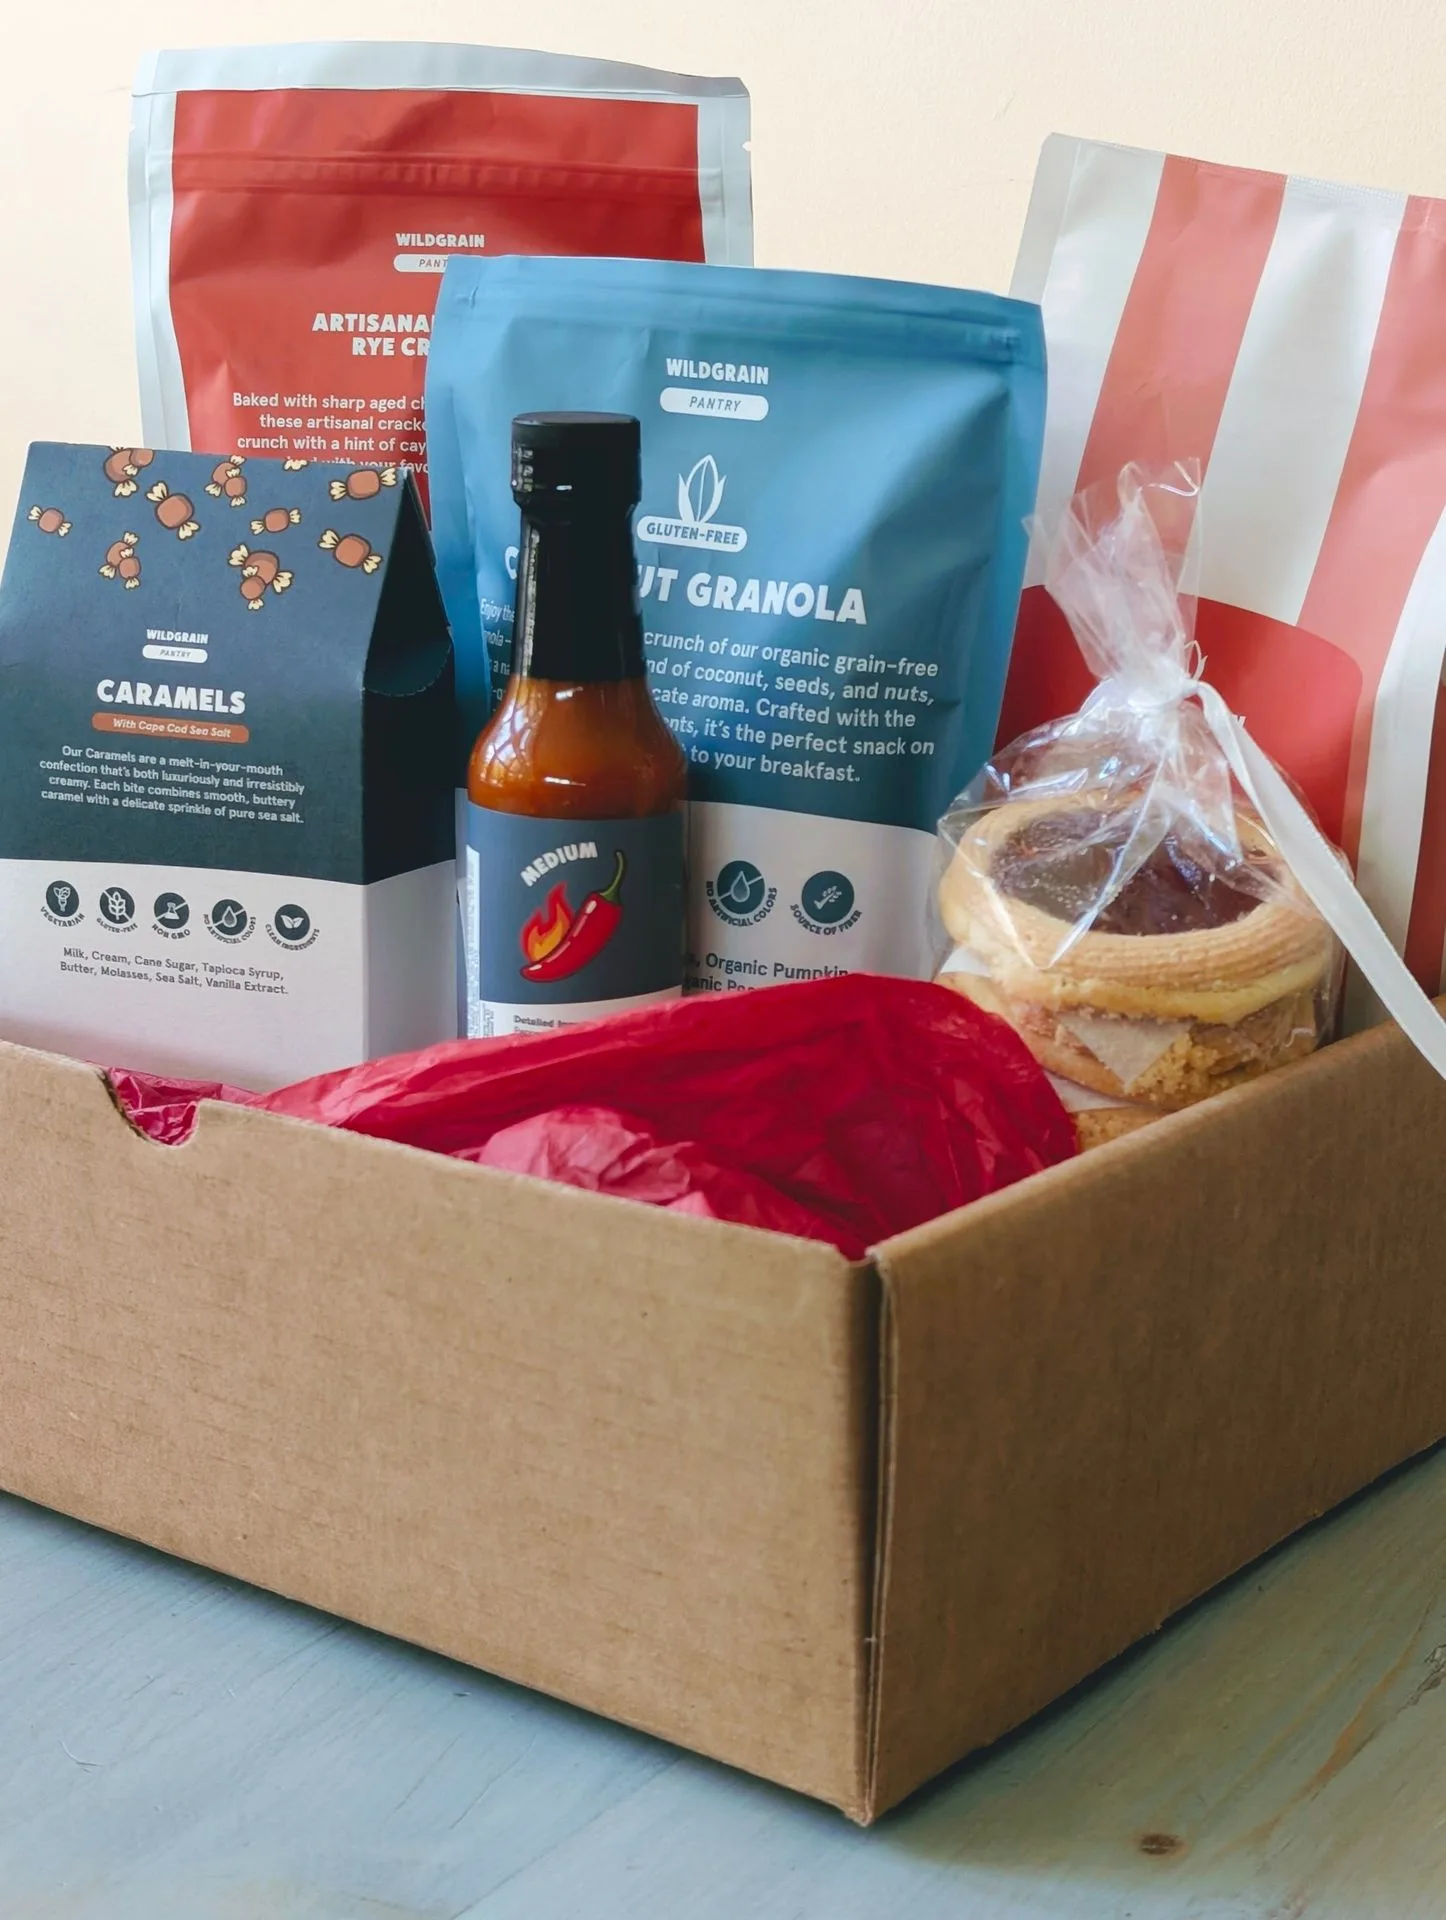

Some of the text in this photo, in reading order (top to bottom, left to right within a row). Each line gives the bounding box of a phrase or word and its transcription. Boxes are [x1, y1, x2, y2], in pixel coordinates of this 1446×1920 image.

[395, 233, 485, 248] WILDGRAIN
[418, 258, 448, 268] PANT
[312, 313, 434, 333] ARTISANA
[352, 337, 395, 356] RYE
[666, 358, 769, 385] WILDGRAIN
[233, 392, 279, 407] Baked
[283, 394, 317, 408] with
[322, 395, 365, 412] sharp
[370, 396, 406, 412] aged
[689, 396, 742, 412] PANTRY
[260, 414, 427, 431] these artisanal crack
[237, 435, 427, 455] crunch with a hint of cay
[646, 522, 740, 545] GLUTEN-FREE
[687, 572, 867, 625] GRANOLA
[146, 629, 209, 644] WILDGRAIN
[644, 631, 704, 652] crunch
[709, 638, 728, 655] of
[731, 643, 759, 659] our
[762, 645, 830, 668] organic
[834, 654, 938, 678] grain-free
[97, 679, 246, 715] CARAMELS
[672, 662, 692, 678] of
[695, 667, 768, 690] coconut,
[775, 675, 835, 699] seeds,
[842, 682, 878, 700] and
[884, 686, 935, 706] nuts,
[692, 694, 750, 714] aroma.
[756, 699, 830, 724] Crafted
[836, 709, 879, 727] with
[885, 709, 916, 727] the
[113, 718, 231, 738] With Cape Cod Sea Salt
[704, 718, 730, 739] it's
[736, 723, 766, 743] the
[771, 730, 847, 754] perfect
[853, 736, 906, 755] snack
[911, 740, 935, 755] on
[62, 745, 283, 776] Our Caramels are a melt-in-your-mouth
[691, 745, 709, 763] to
[715, 749, 756, 769] your
[761, 755, 861, 783] breakfast.
[40, 760, 304, 795] confection that's both luxuriously and irresistibly
[49, 776, 296, 810] creamy. Each bite combines smooth, buttery
[41, 790, 304, 823] caramel with a delicate sprinkle of pure sea salt.
[520, 841, 598, 887] MEDIUM
[40, 906, 85, 928] VEGETARIAN
[708, 898, 753, 927] ARTIFICIAL
[753, 886, 778, 923] COLORS
[790, 903, 863, 936] SOURCE OF FIBER
[152, 924, 191, 940] NON GMO
[60, 961, 288, 994] Butter, Molasses, Sea Salt, Vanilla Extract.
[64, 947, 284, 981] Milk, Cream, Cane Sugar, Tapioca Syrup,
[706, 953, 768, 975] Organic
